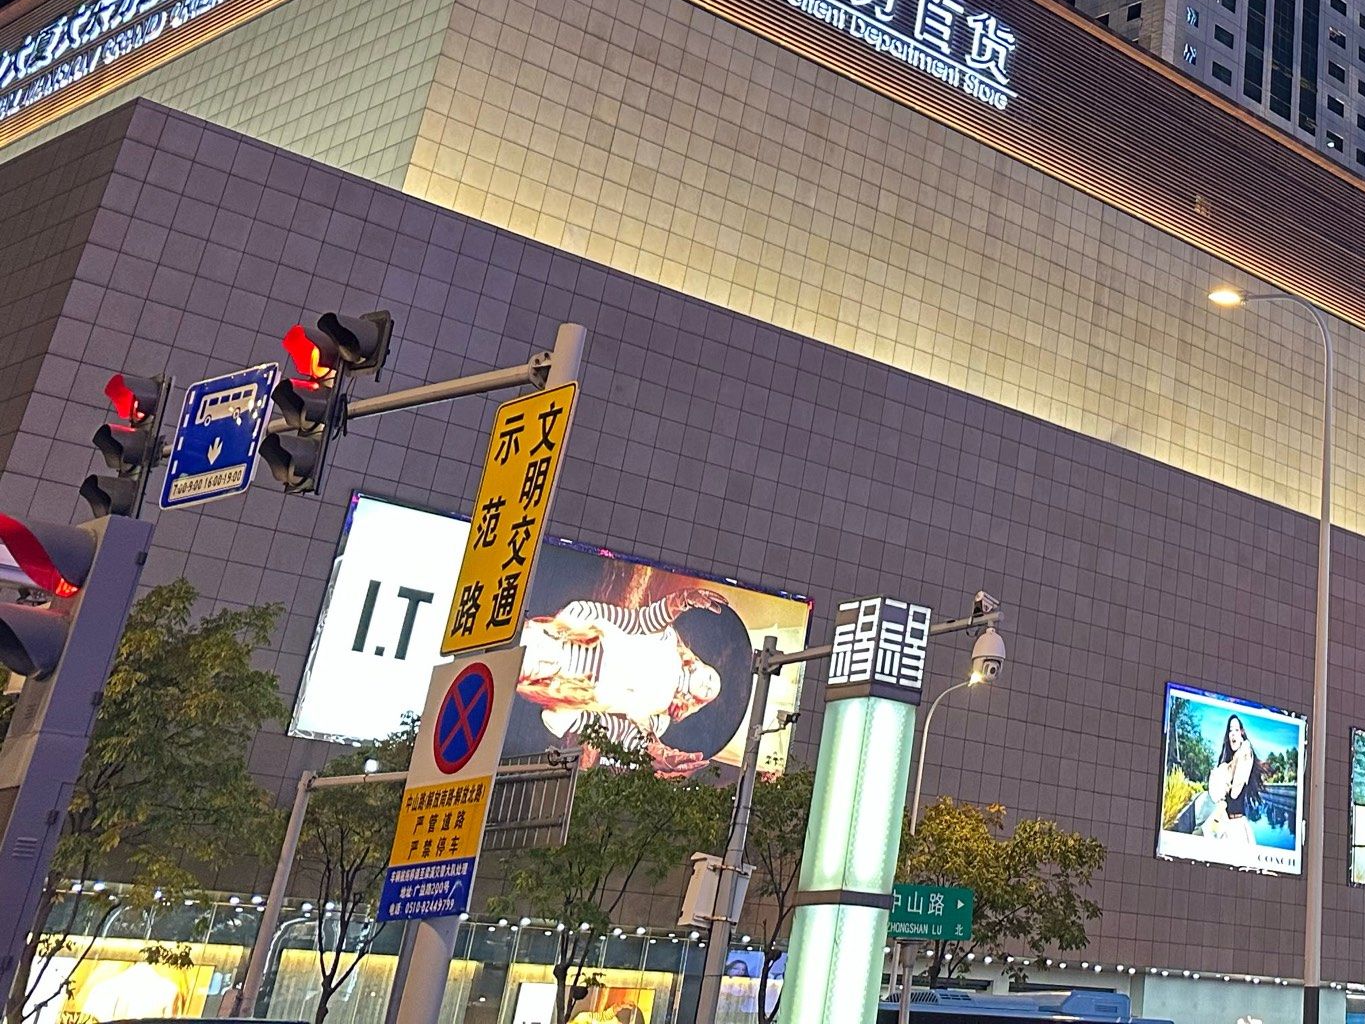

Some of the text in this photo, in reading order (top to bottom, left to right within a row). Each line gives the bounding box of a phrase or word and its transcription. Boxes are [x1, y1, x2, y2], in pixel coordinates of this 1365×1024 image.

[849, 13, 960, 88] Department
[963, 72, 1009, 111] Store
[450, 414, 526, 638] 示范路
[486, 401, 564, 630] 文明交通
[352, 579, 434, 660] I.T
[407, 835, 460, 860] 严禁停车
[412, 810, 466, 835] 严管道路
[931, 923, 942, 935] LU
[954, 923, 964, 936] 北
